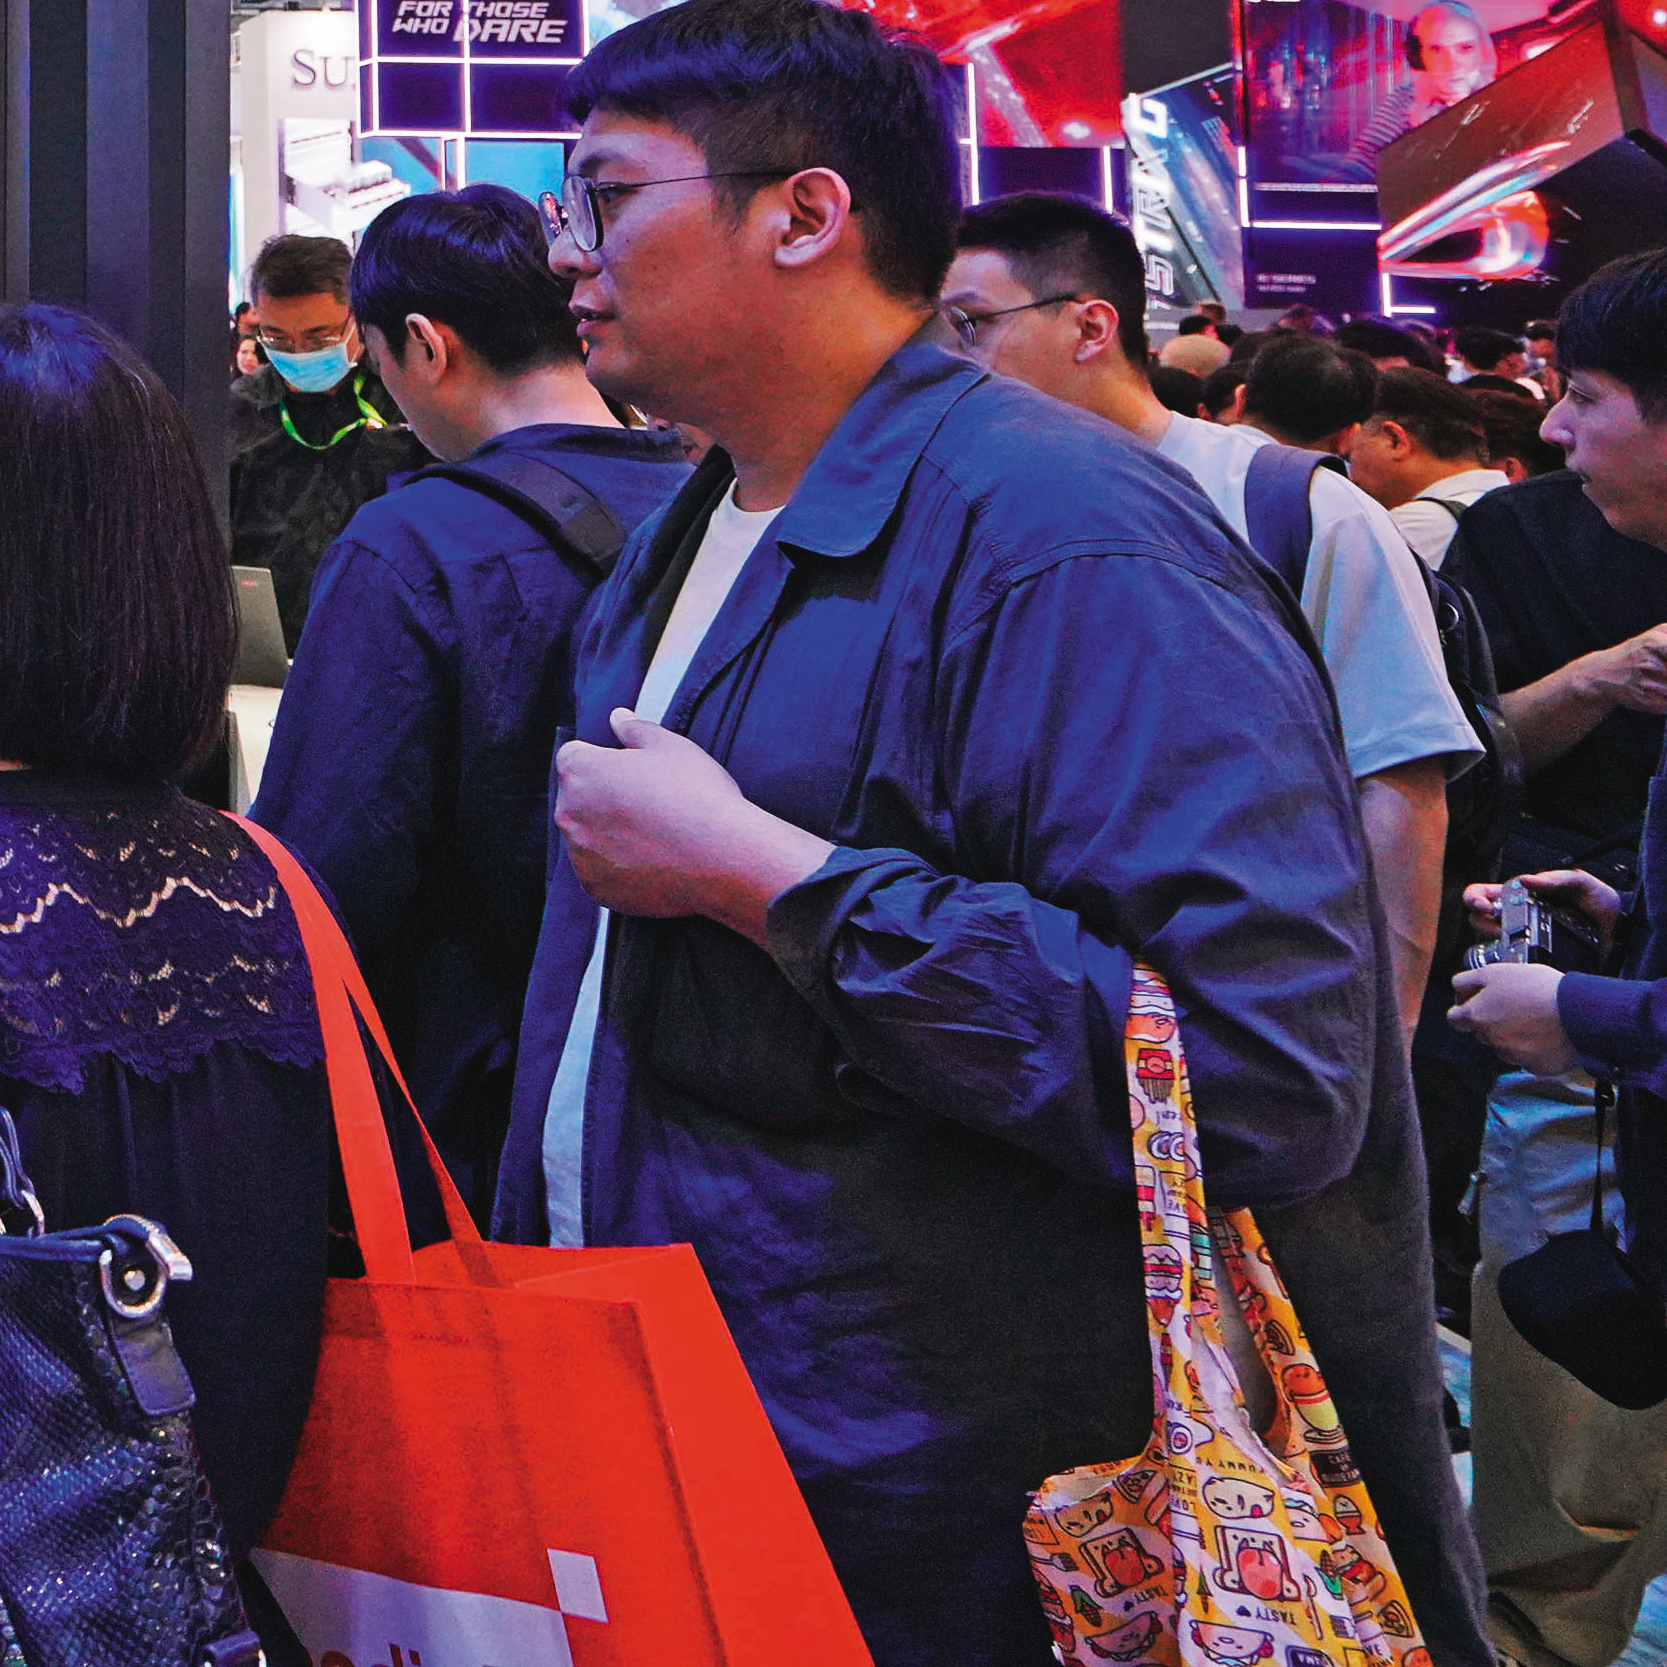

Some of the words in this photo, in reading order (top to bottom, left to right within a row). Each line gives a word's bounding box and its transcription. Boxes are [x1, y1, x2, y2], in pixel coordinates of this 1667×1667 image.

[397, 0, 453, 18] FOR
[462, 1, 550, 19] THOSE
[392, 17, 449, 35] WHO
[452, 19, 569, 44] DARE
[291, 48, 357, 90] SU
[1255, 1606, 1298, 1627] TASTY
